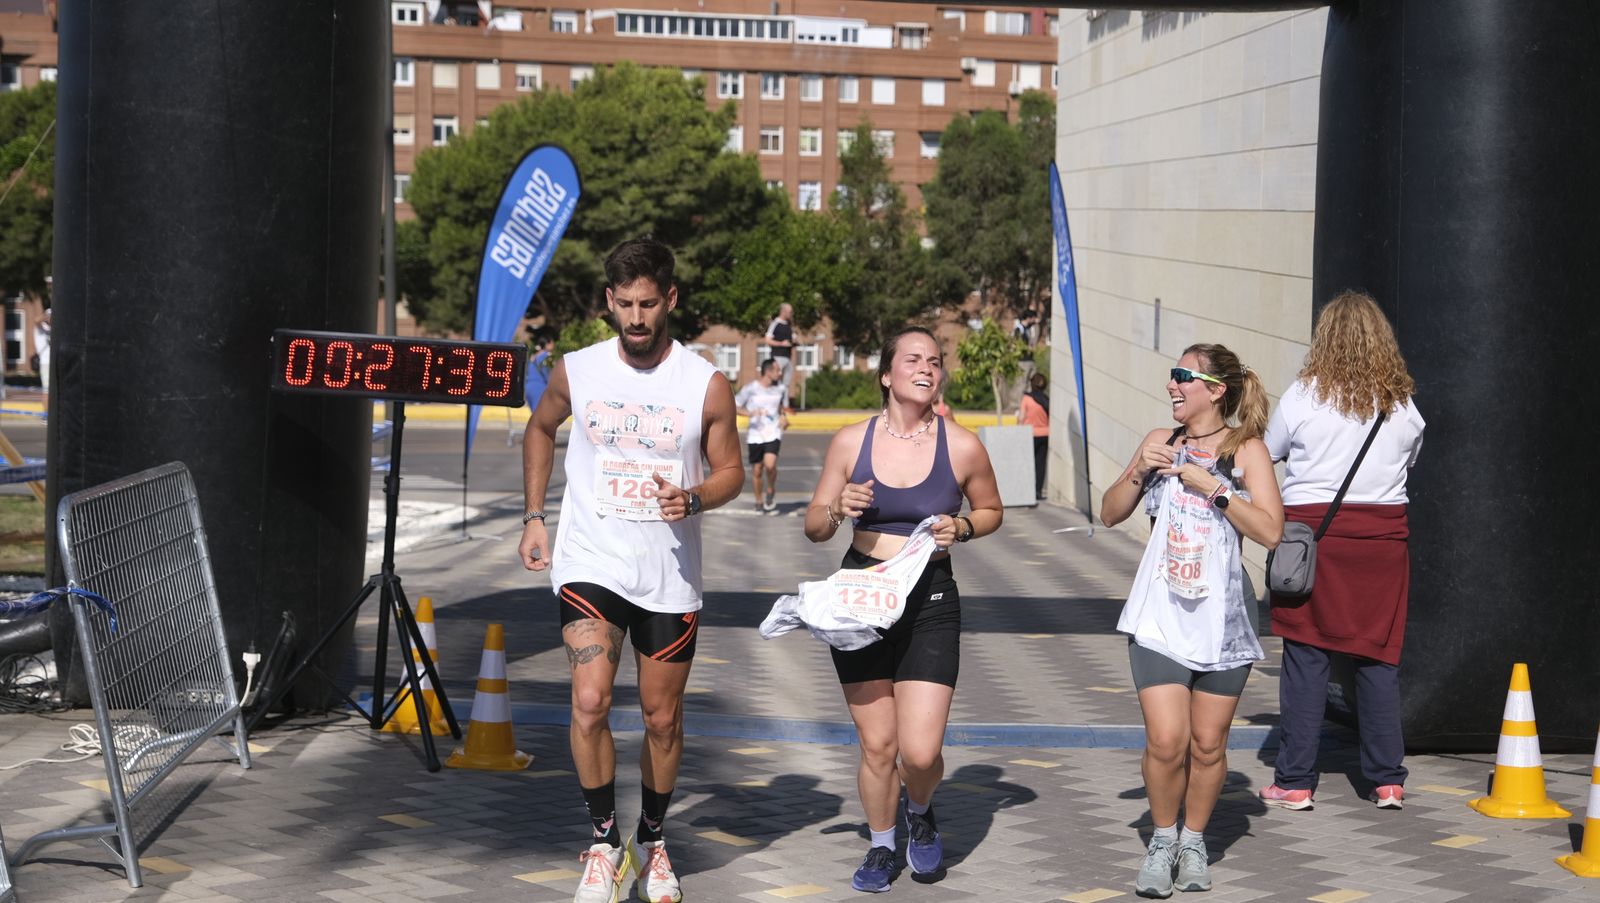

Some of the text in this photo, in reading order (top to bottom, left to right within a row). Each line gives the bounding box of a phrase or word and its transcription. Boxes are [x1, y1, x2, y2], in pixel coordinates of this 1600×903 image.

[607, 478, 656, 500] 126
[1167, 558, 1202, 580] 208
[838, 587, 898, 610] 1210
